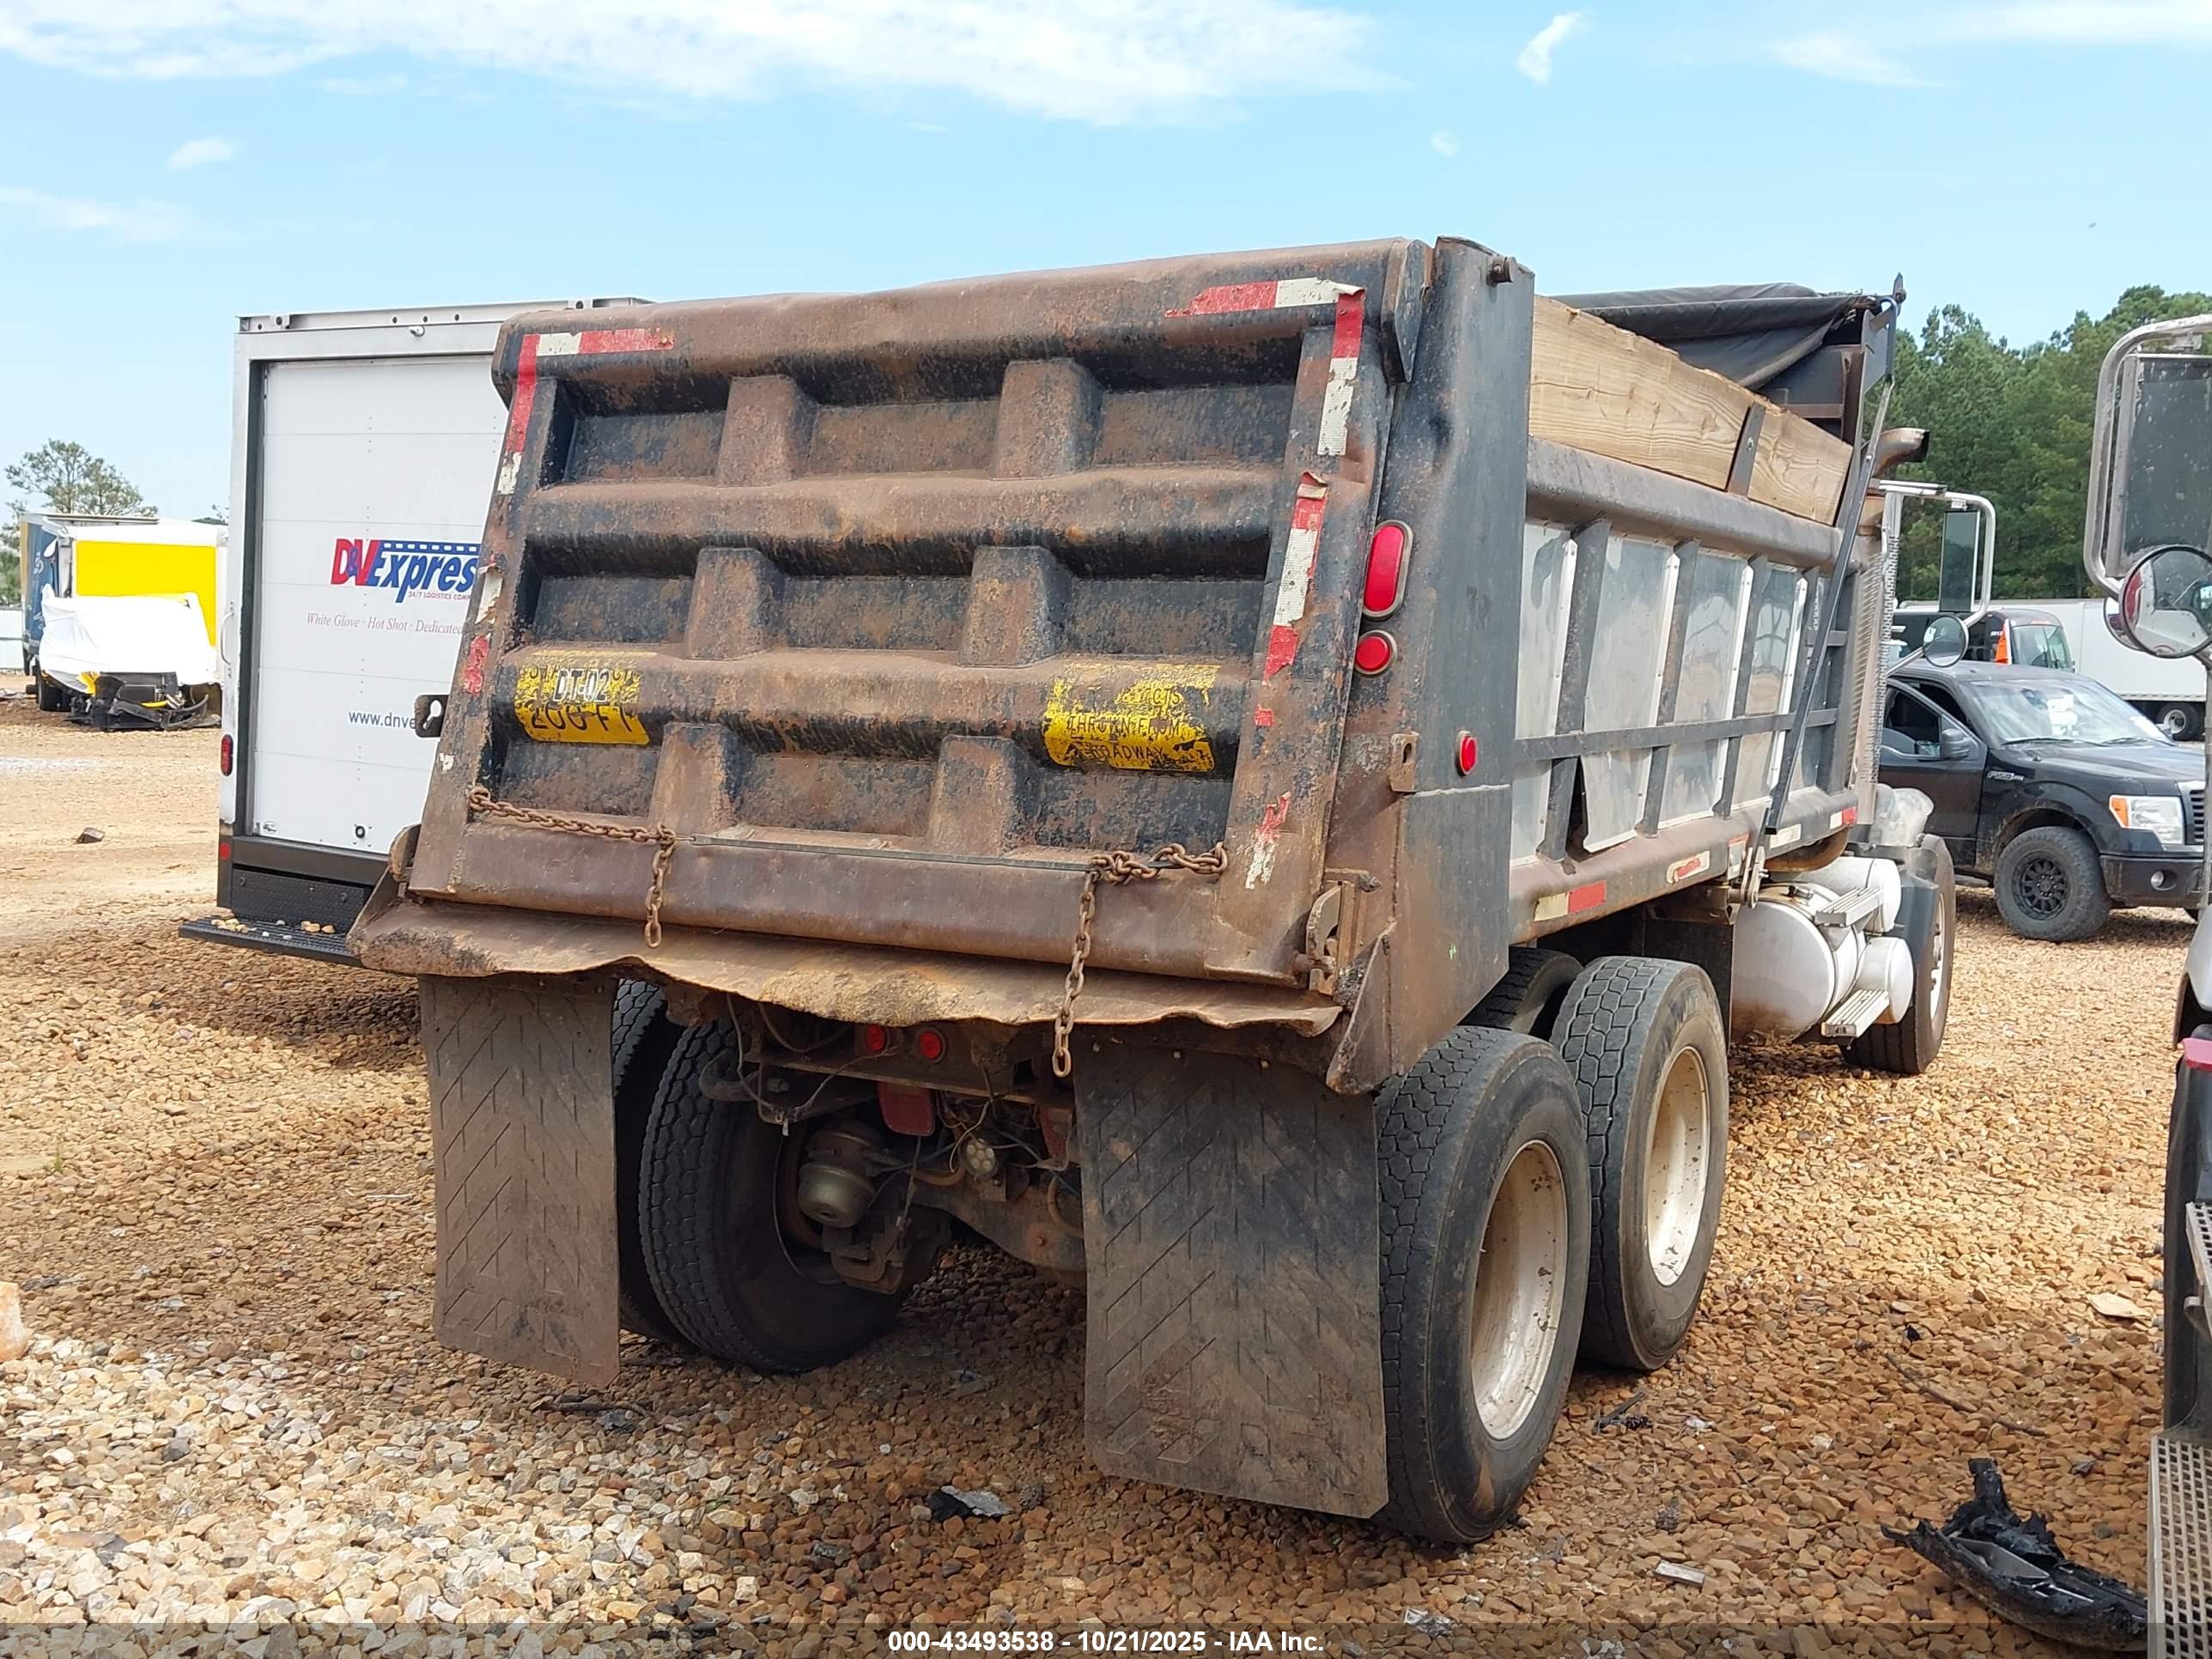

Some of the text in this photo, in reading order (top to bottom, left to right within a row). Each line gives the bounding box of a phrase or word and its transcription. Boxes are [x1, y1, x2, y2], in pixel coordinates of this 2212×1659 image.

[307, 612, 331, 626] White
[334, 614, 360, 629] Glove
[368, 617, 385, 630] Hot
[386, 618, 408, 632] Shot
[349, 712, 416, 730] www.dnve
